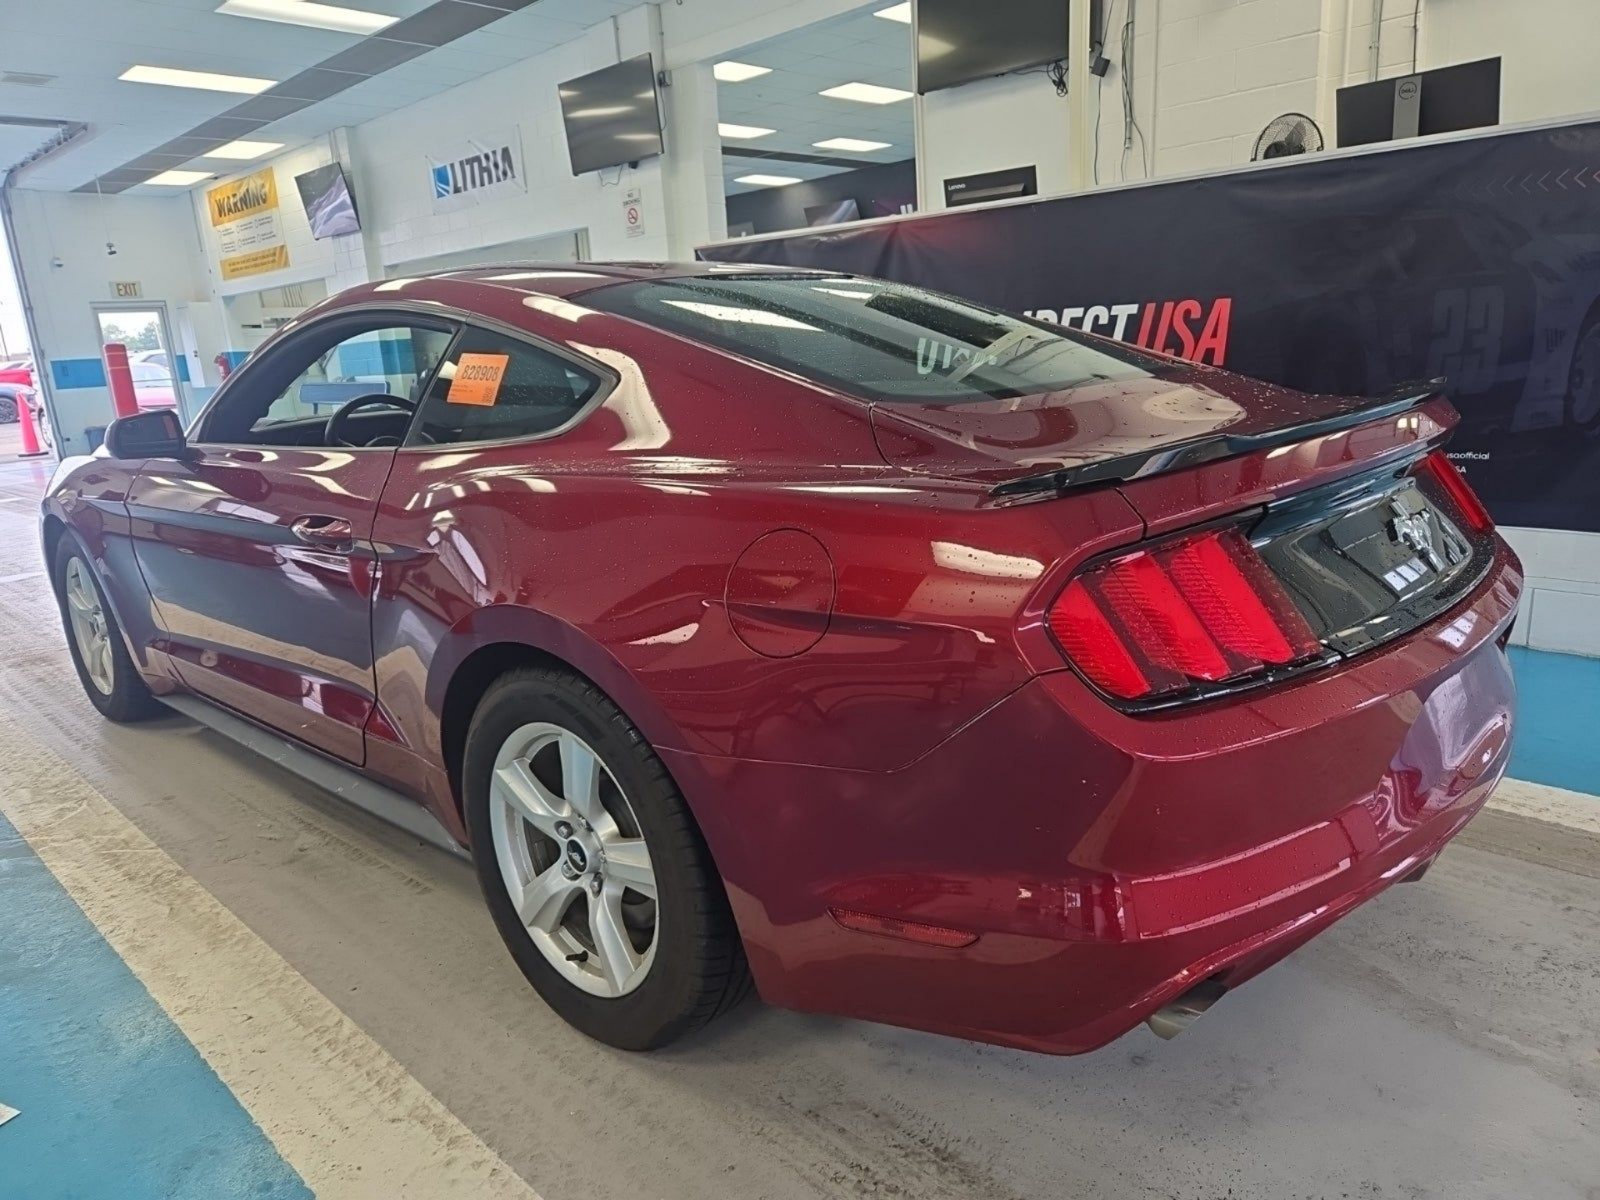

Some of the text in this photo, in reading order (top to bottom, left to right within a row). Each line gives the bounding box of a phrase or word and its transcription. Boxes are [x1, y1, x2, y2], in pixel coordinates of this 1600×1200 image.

[449, 146, 516, 195] LITHIA
[215, 182, 268, 218] WARNING
[115, 282, 138, 297] EXIT
[1136, 297, 1232, 366] USA
